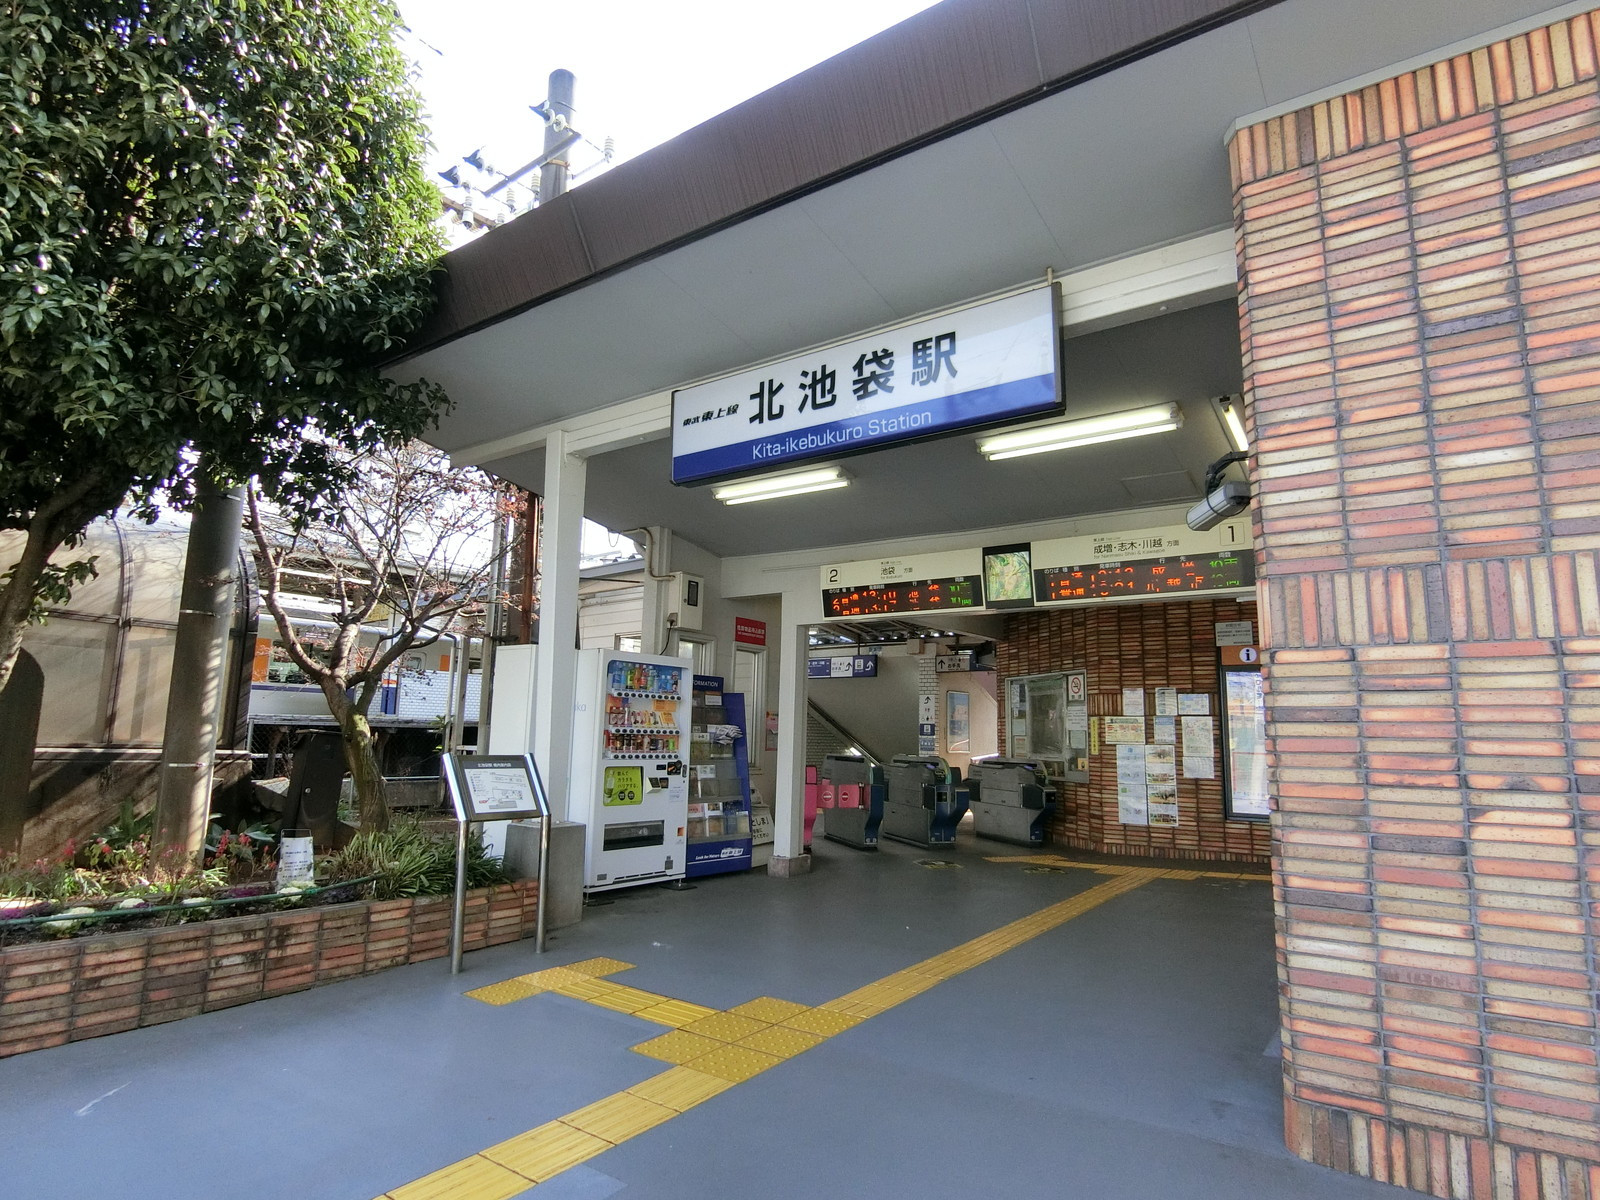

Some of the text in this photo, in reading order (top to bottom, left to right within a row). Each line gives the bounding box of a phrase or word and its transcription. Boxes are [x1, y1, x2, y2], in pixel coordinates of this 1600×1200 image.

[748, 331, 957, 425] 北池袋駅
[752, 410, 932, 460] Kita-ikebukuro Station
[1228, 526, 1235, 542] 1
[829, 569, 838, 583] 2
